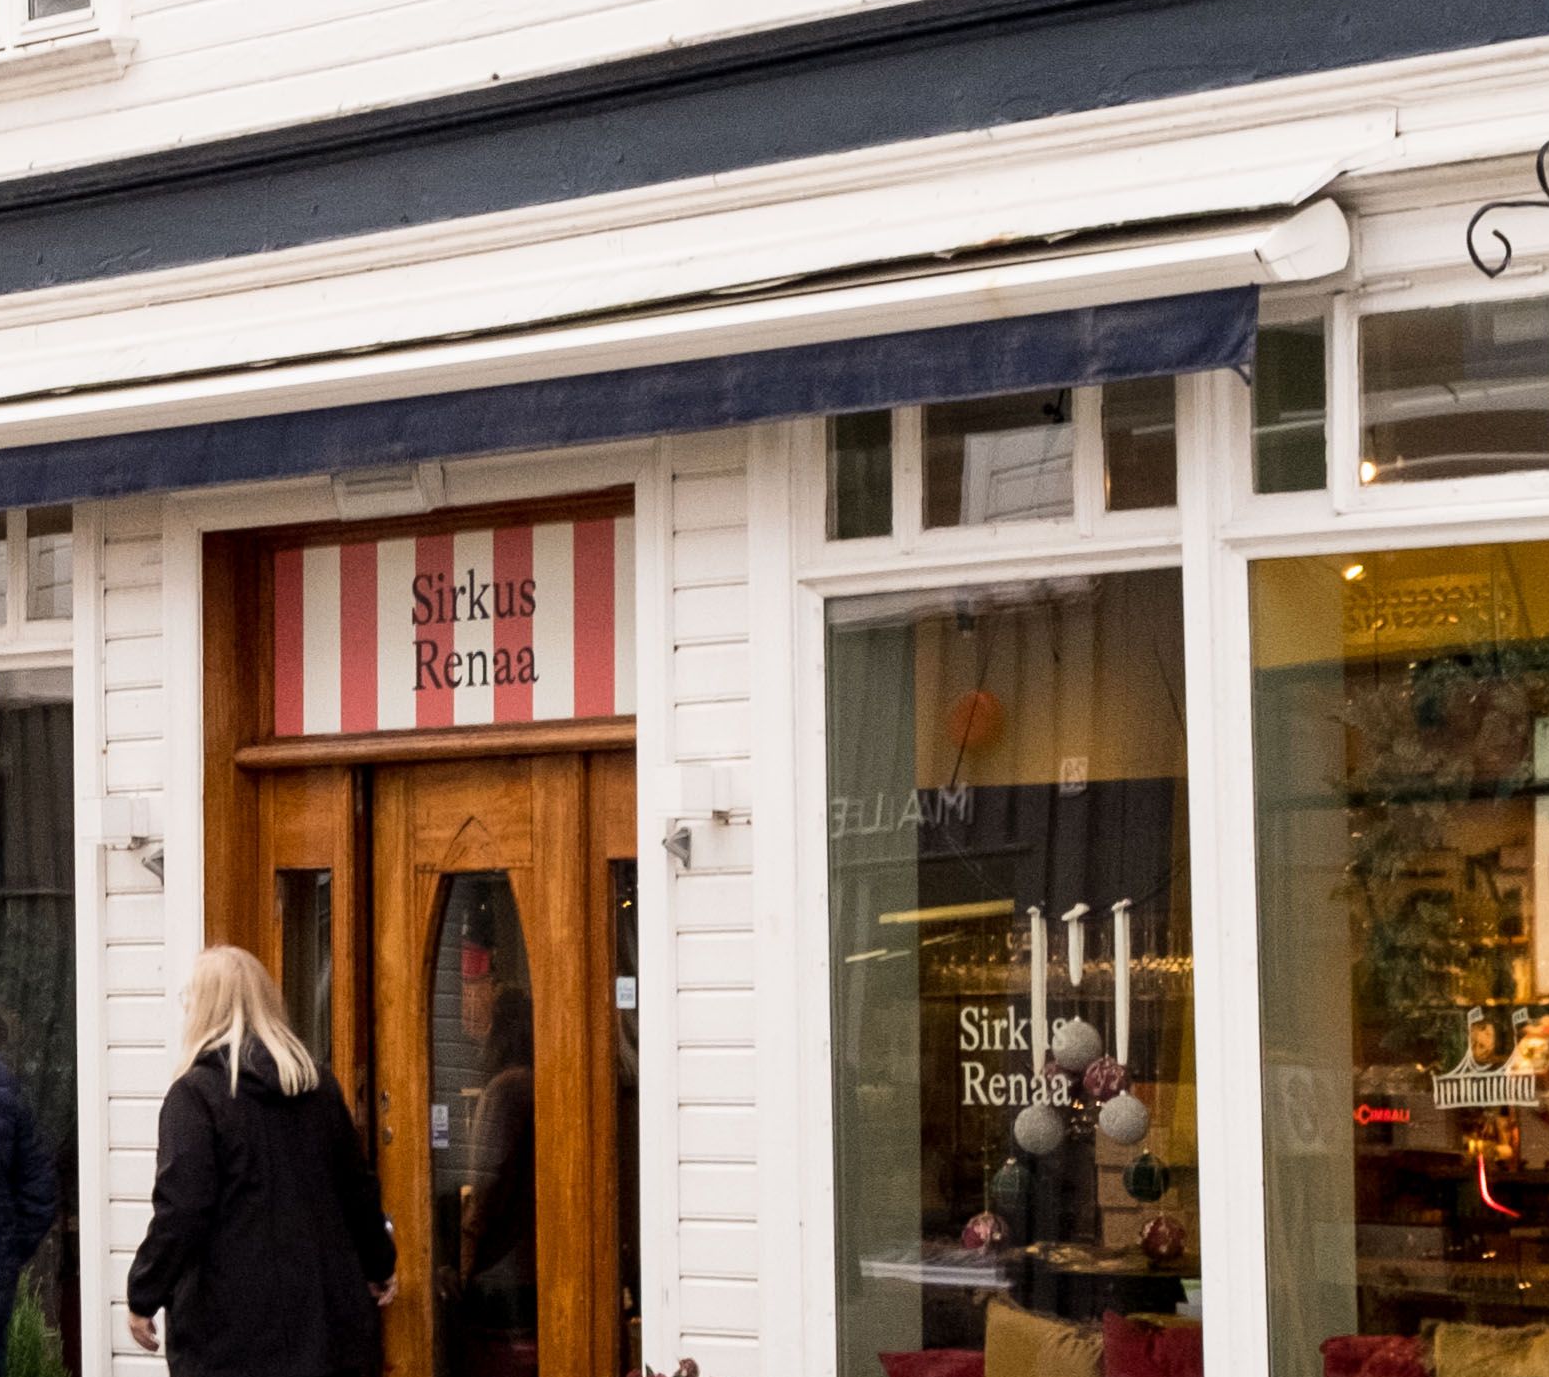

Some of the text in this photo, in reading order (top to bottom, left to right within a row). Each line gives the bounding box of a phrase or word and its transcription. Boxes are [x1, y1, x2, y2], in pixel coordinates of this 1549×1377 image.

[412, 568, 536, 626] Sirkus
[412, 639, 539, 691] Renaa
[961, 1061, 1072, 1107] Renaa
